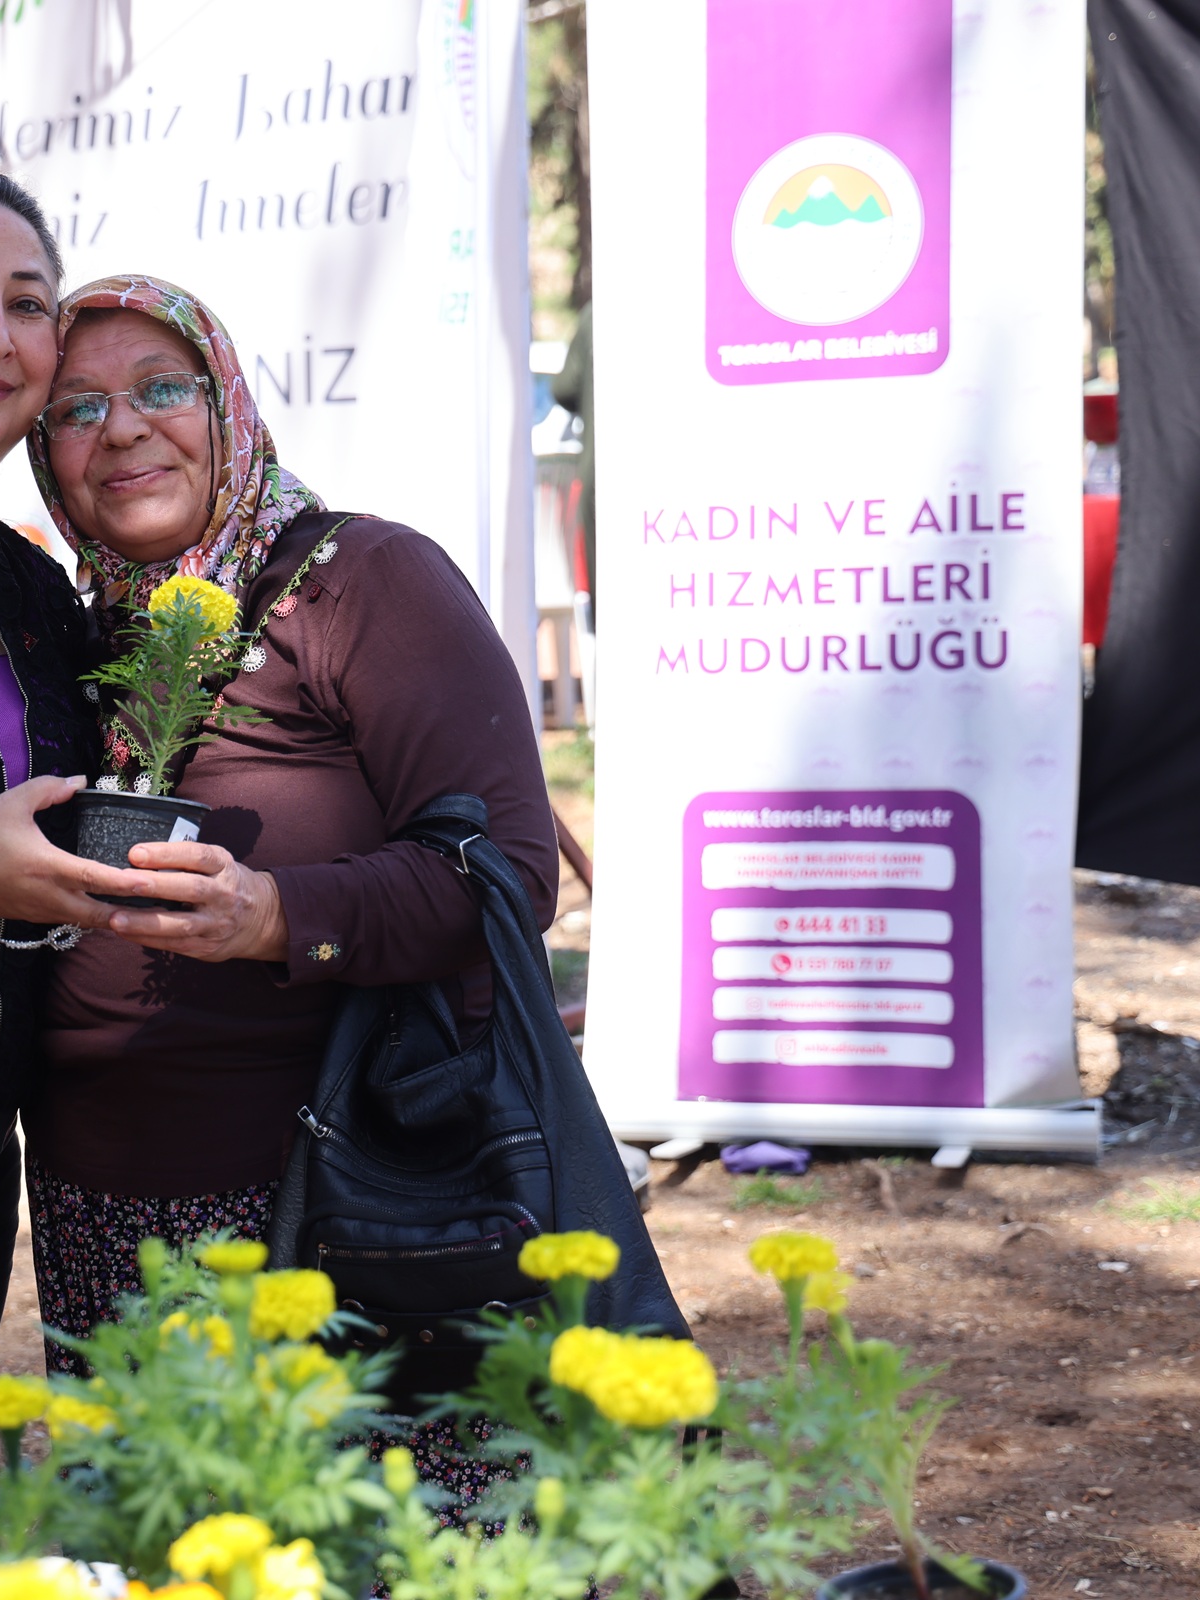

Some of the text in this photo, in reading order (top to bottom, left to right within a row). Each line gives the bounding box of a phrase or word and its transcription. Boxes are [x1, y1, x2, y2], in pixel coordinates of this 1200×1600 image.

[255, 334, 358, 407] NİZ
[643, 480, 1027, 545] KADIN VE AİLE
[795, 915, 833, 934] 444
